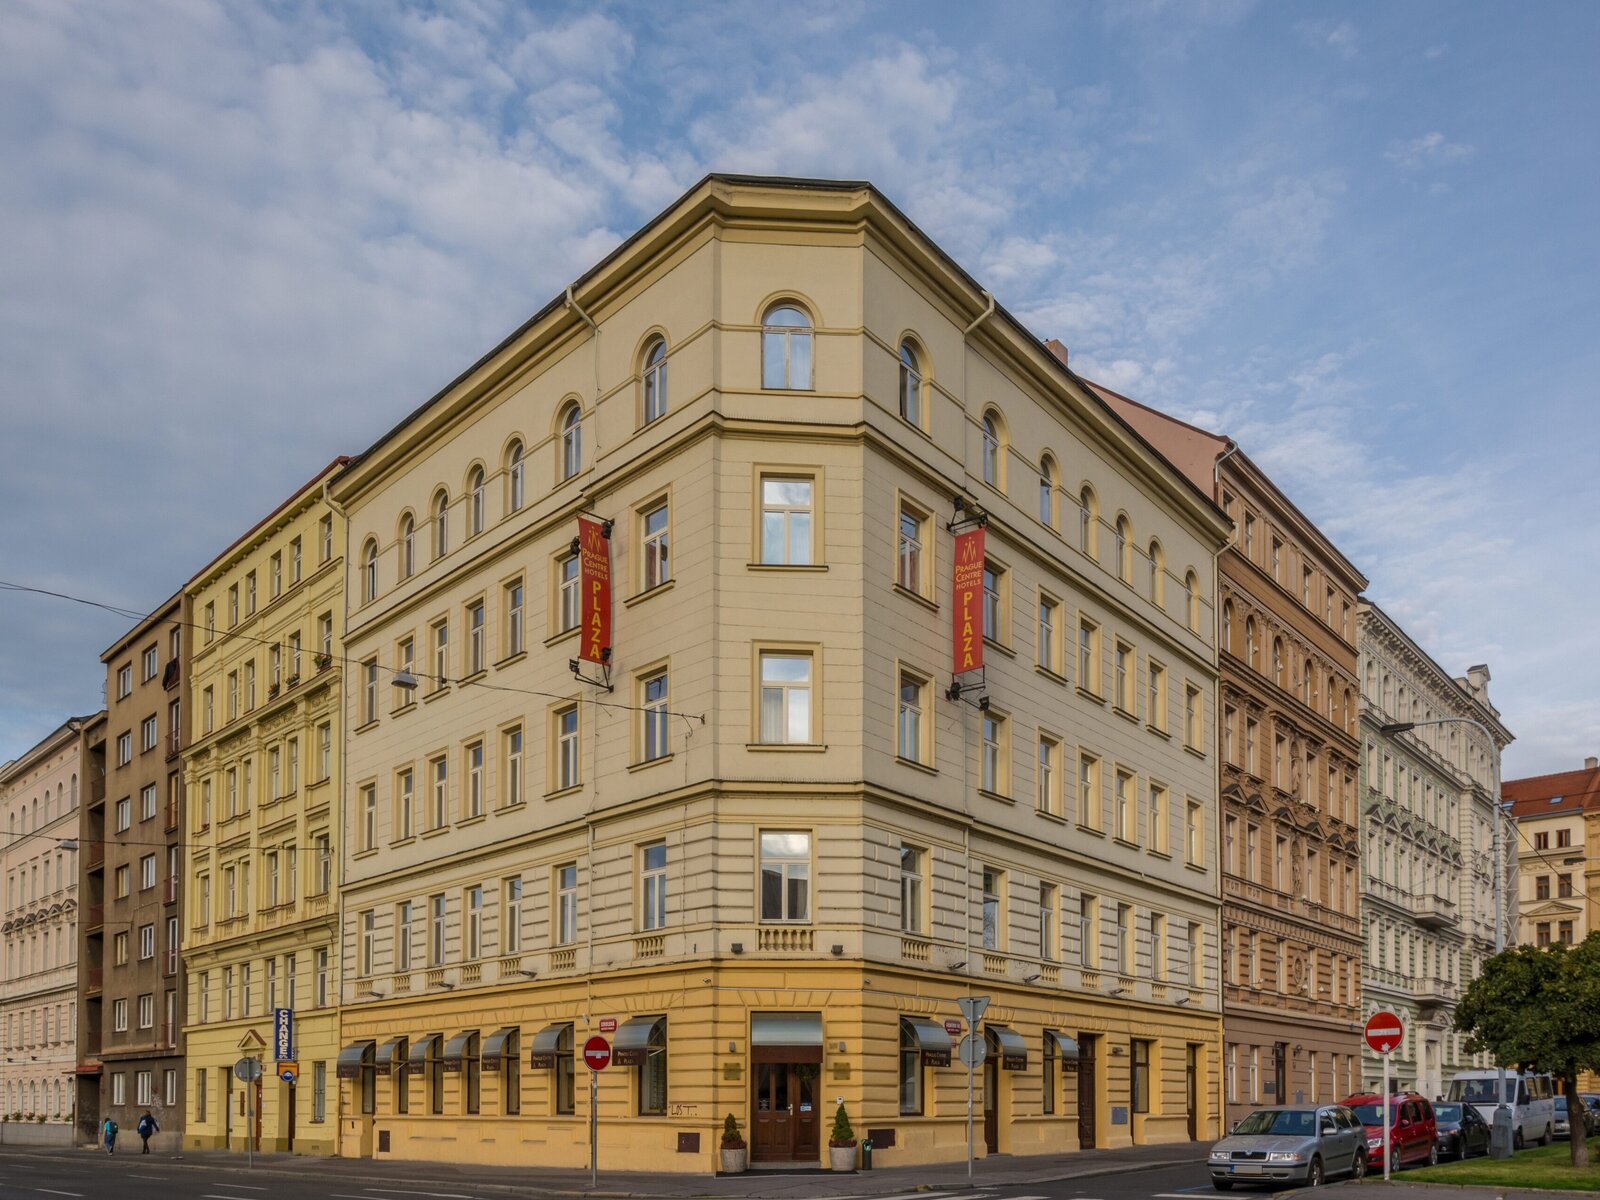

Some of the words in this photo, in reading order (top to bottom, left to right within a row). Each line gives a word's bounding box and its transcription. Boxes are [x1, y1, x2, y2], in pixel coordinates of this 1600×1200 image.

[582, 548, 609, 564] PRAGUE
[583, 557, 608, 573] CENTRE
[955, 561, 983, 575] PRAGUE
[584, 567, 608, 581] HOTELS
[955, 570, 982, 583] CENTRE
[956, 579, 982, 590] HOTELS
[590, 580, 602, 659] PLAZA
[962, 592, 973, 667] PLAZA
[279, 1009, 289, 1055] CHANGE
